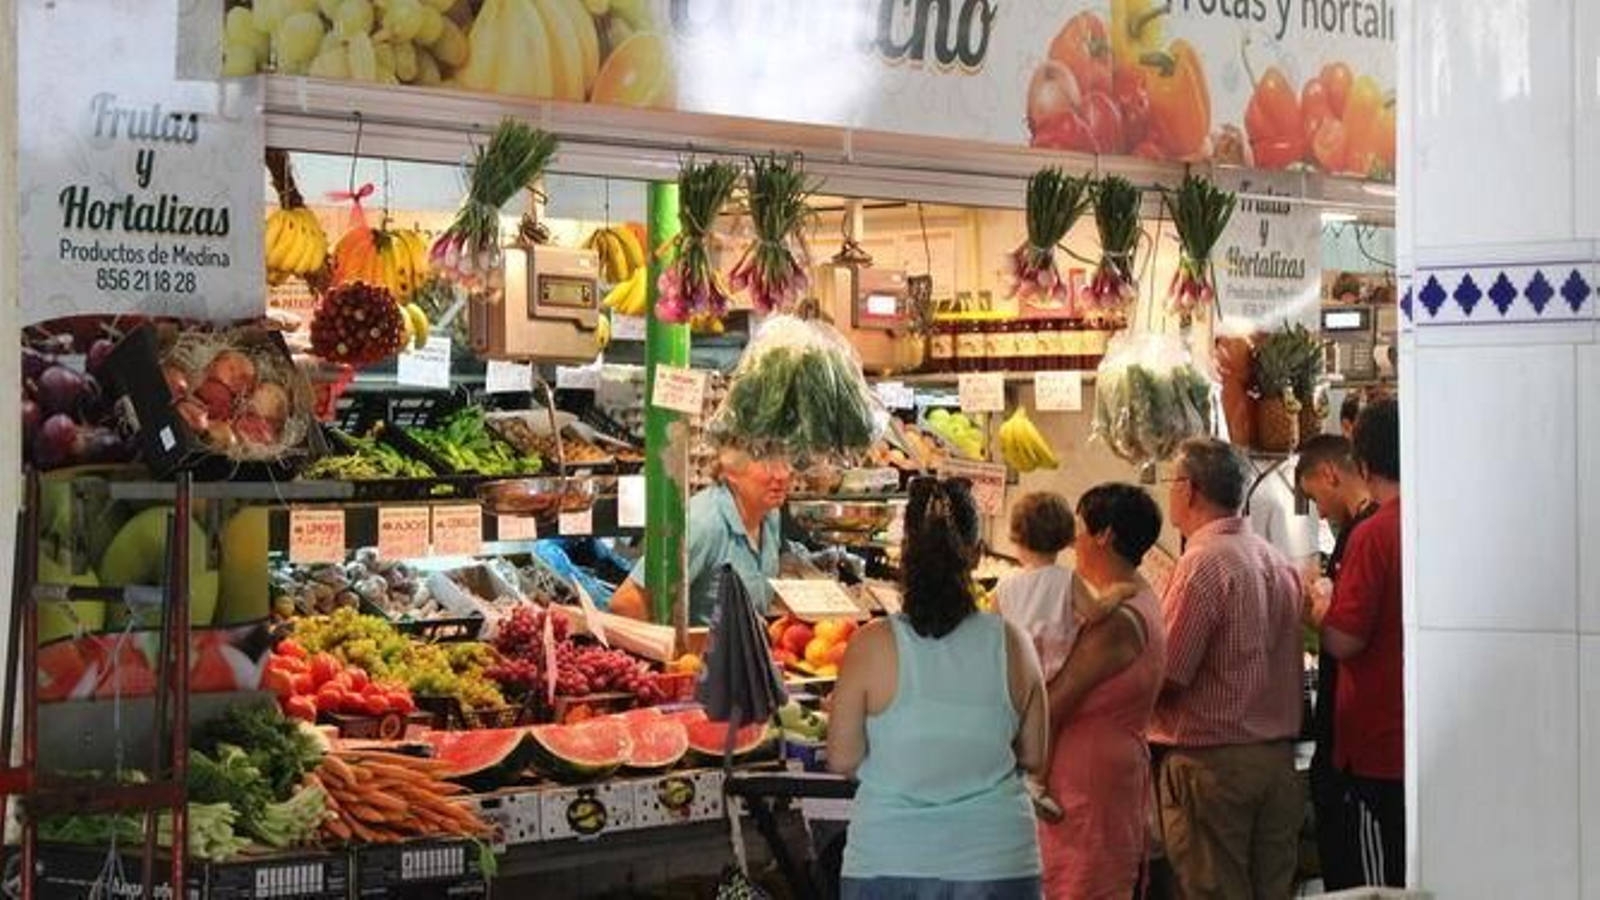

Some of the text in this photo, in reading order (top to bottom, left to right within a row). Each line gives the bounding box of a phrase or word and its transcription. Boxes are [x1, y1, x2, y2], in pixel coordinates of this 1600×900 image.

[1274, 0, 1291, 41] y
[91, 92, 199, 144] Frutas
[136, 148, 155, 189] y
[58, 185, 230, 237] Hortalizas
[1258, 218, 1270, 248] y
[59, 238, 231, 268] Productos de Medina
[1226, 246, 1306, 280] Hortalizas
[97, 268, 130, 291] 856
[174, 272, 197, 294] 28
